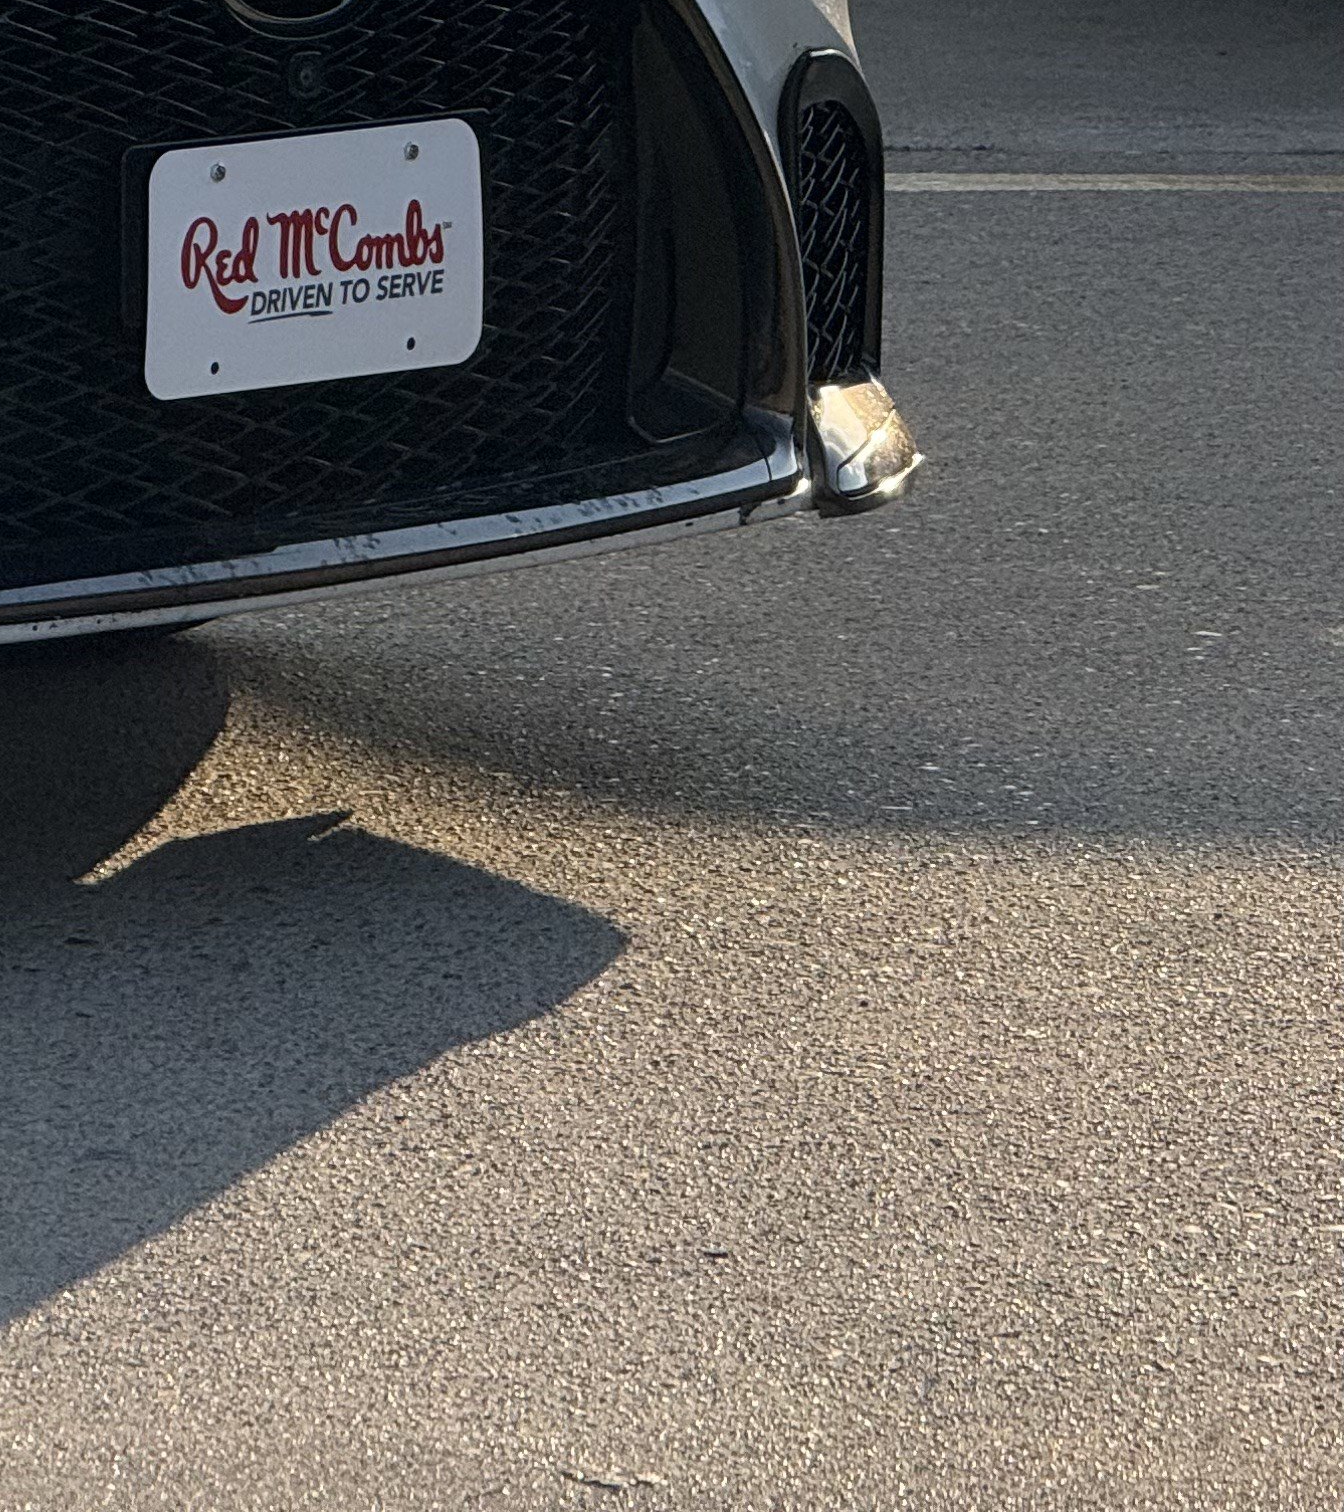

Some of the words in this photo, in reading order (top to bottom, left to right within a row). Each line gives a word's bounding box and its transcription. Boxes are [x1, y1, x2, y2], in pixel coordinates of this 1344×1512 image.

[180, 216, 260, 315] Red
[266, 198, 445, 279] McCombs
[250, 281, 334, 317] DRIVEN
[339, 277, 372, 306] TO
[375, 268, 446, 301] SERVE
